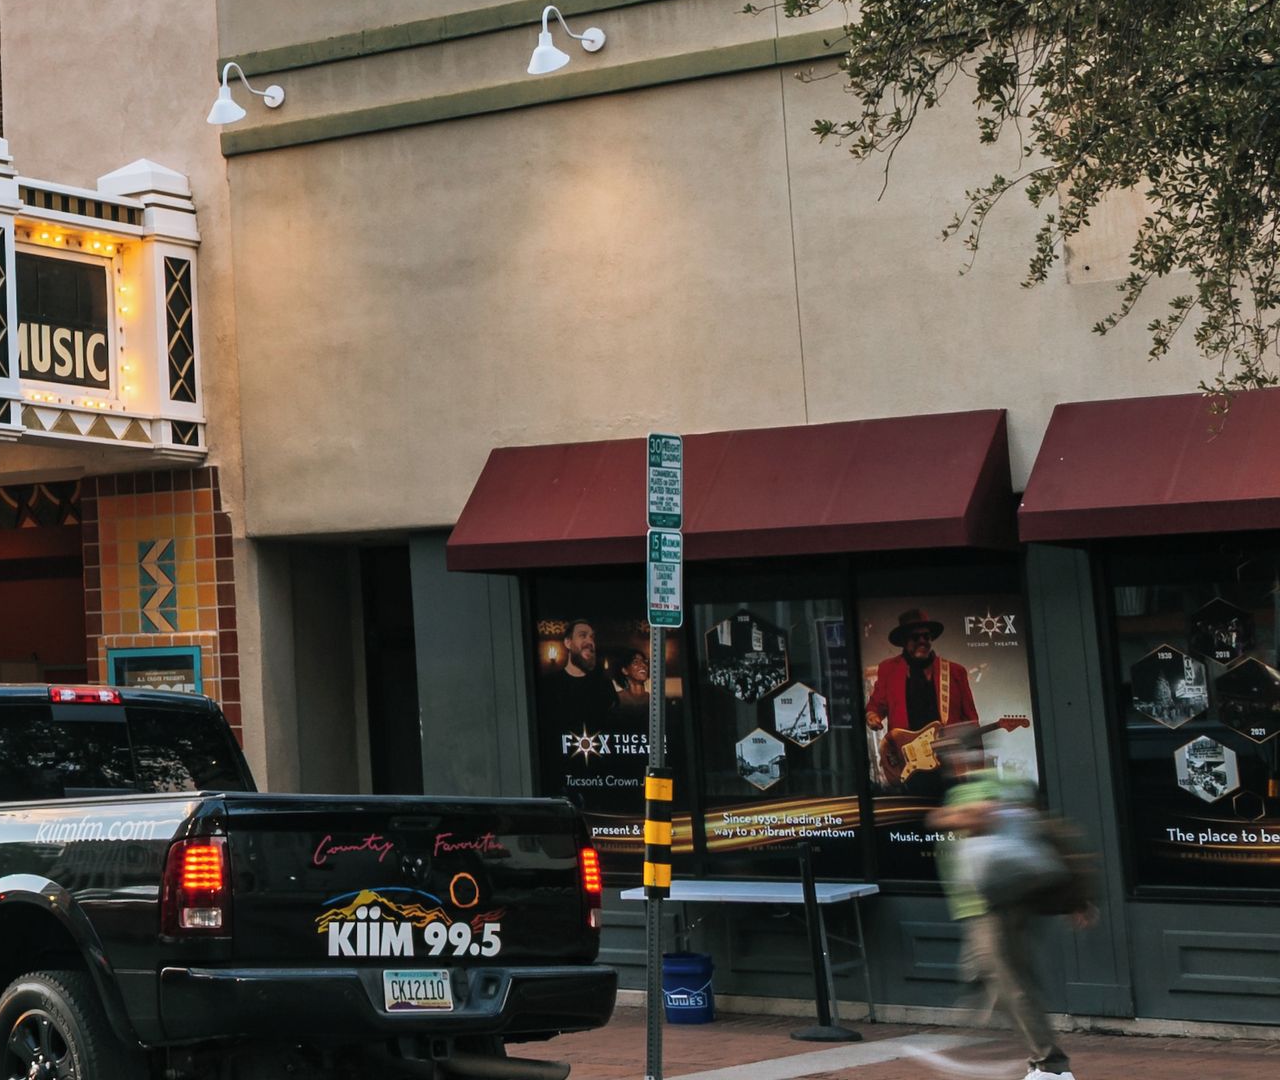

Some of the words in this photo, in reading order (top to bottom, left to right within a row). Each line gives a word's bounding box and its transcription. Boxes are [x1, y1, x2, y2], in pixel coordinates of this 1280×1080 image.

[650, 438, 661, 453] 30
[566, 775, 603, 787] Tucson's
[605, 775, 638, 787] Crown
[723, 813, 751, 824] Since
[783, 813, 822, 827] leading
[824, 814, 842, 825] the
[35, 815, 157, 844] kiimfm.com
[592, 825, 630, 837] present
[632, 825, 640, 835] &
[714, 829, 733, 839] way
[736, 827, 747, 837] to
[759, 827, 796, 838] vibrant
[799, 828, 855, 838] downtown
[890, 831, 922, 842] Music,
[925, 832, 945, 842] arts
[948, 831, 955, 841] &
[1166, 828, 1195, 841] The
[1198, 828, 1238, 845] place
[1241, 829, 1258, 842] to
[1261, 828, 1280, 843] be
[314, 834, 394, 865] Country
[424, 922, 501, 957] 99.5
[391, 980, 444, 1001] CK12110
